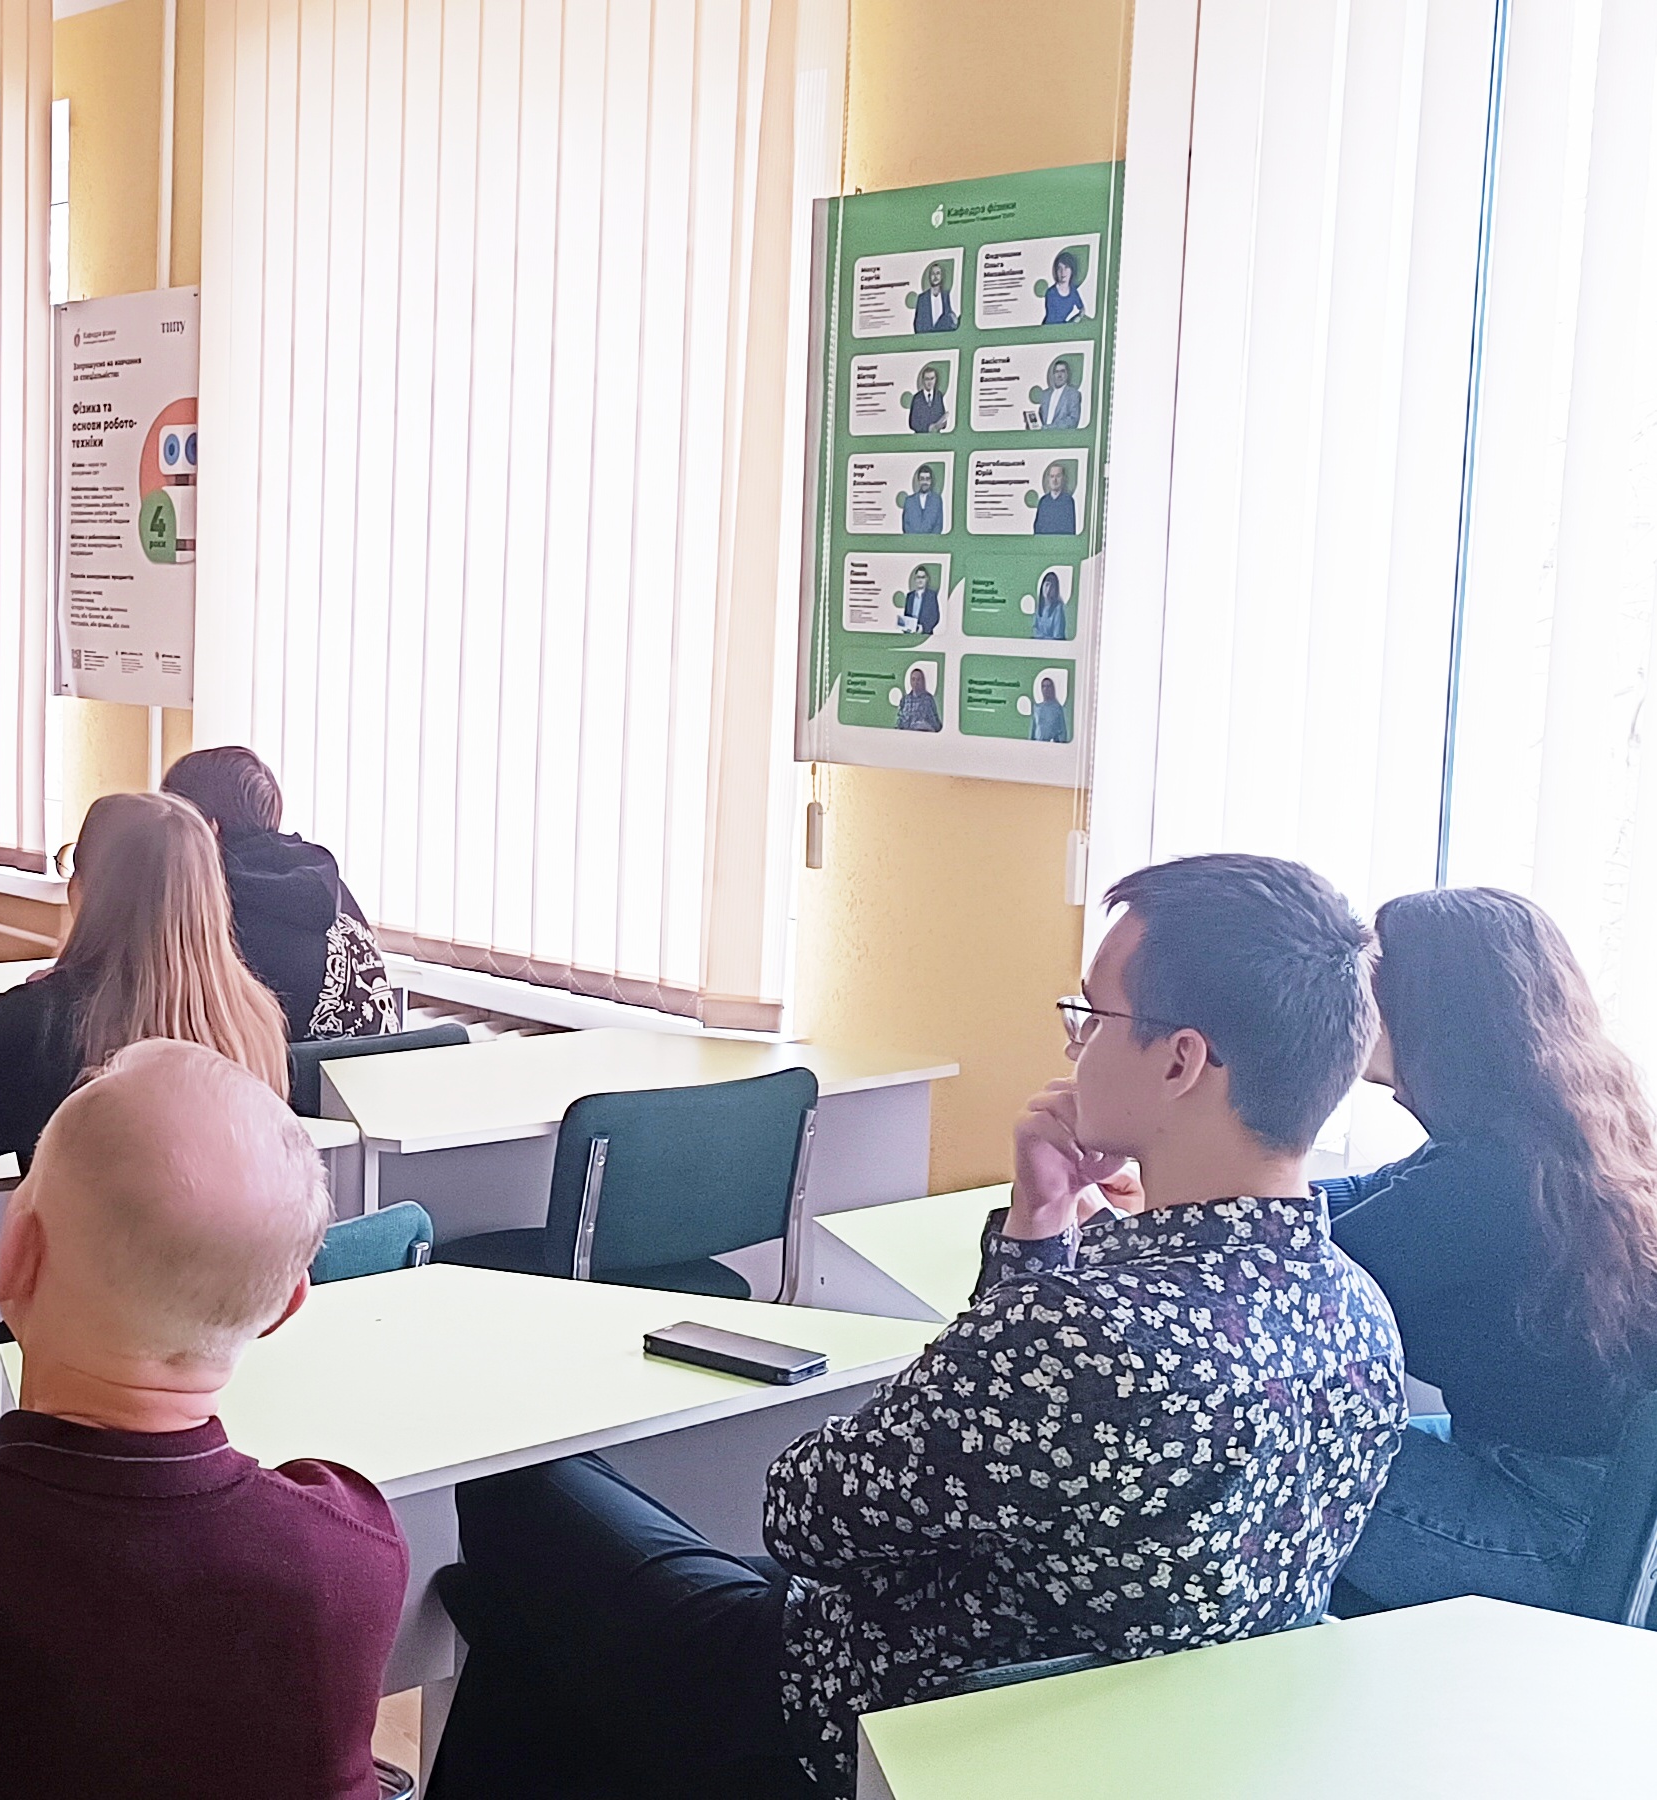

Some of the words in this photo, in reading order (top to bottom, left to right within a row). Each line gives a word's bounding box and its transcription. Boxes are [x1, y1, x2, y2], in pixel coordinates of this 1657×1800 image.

[947, 205, 985, 217] Кафедра
[72, 401, 101, 415] Фізика
[102, 403, 112, 412] та
[72, 421, 102, 431] основи
[103, 417, 137, 432] робото-
[71, 435, 104, 448] техніки
[150, 505, 166, 537] 4
[149, 540, 166, 550] роки
